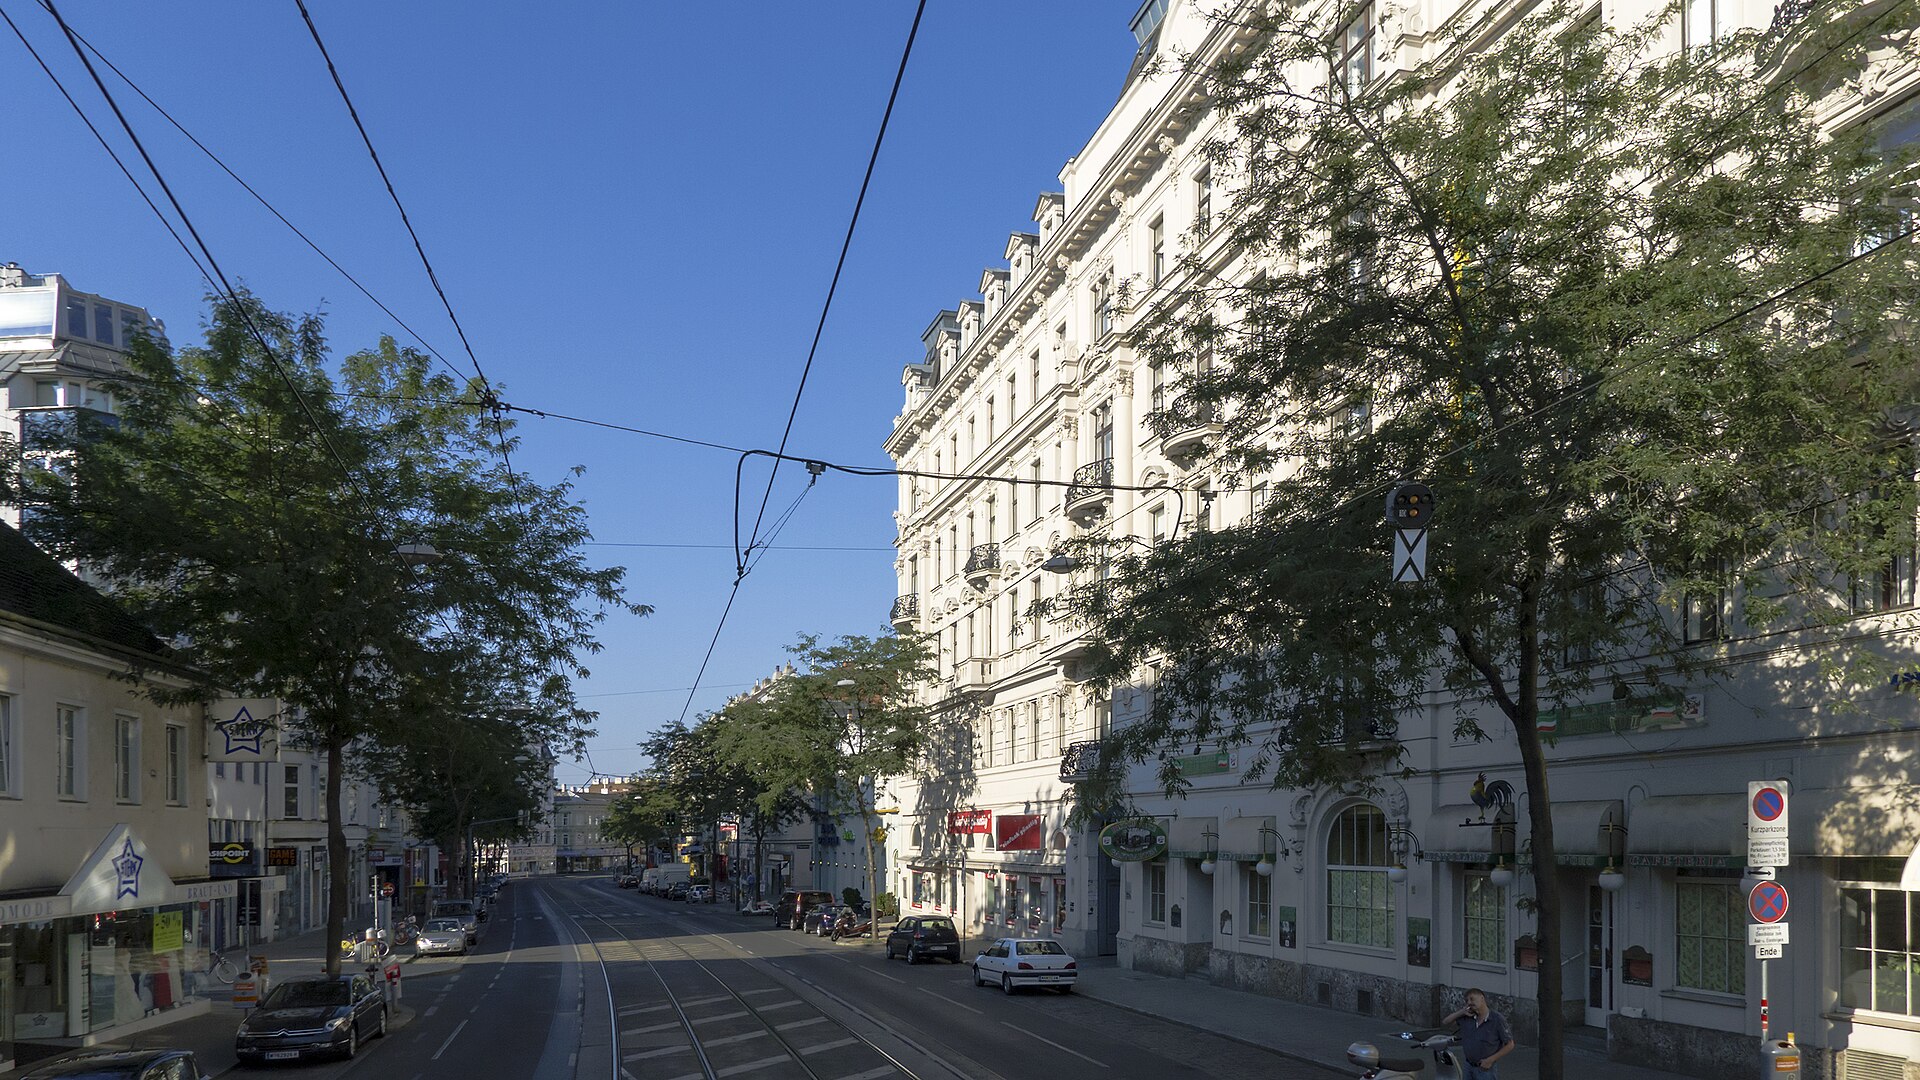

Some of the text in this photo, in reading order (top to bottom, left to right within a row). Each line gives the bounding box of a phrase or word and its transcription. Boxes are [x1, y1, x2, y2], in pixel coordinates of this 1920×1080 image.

[1750, 825, 1787, 835] Kurzparkzone
[270, 849, 296, 859] GAME
[1630, 853, 1726, 867] CAFETERIA
[1759, 947, 1778, 956] Ende
